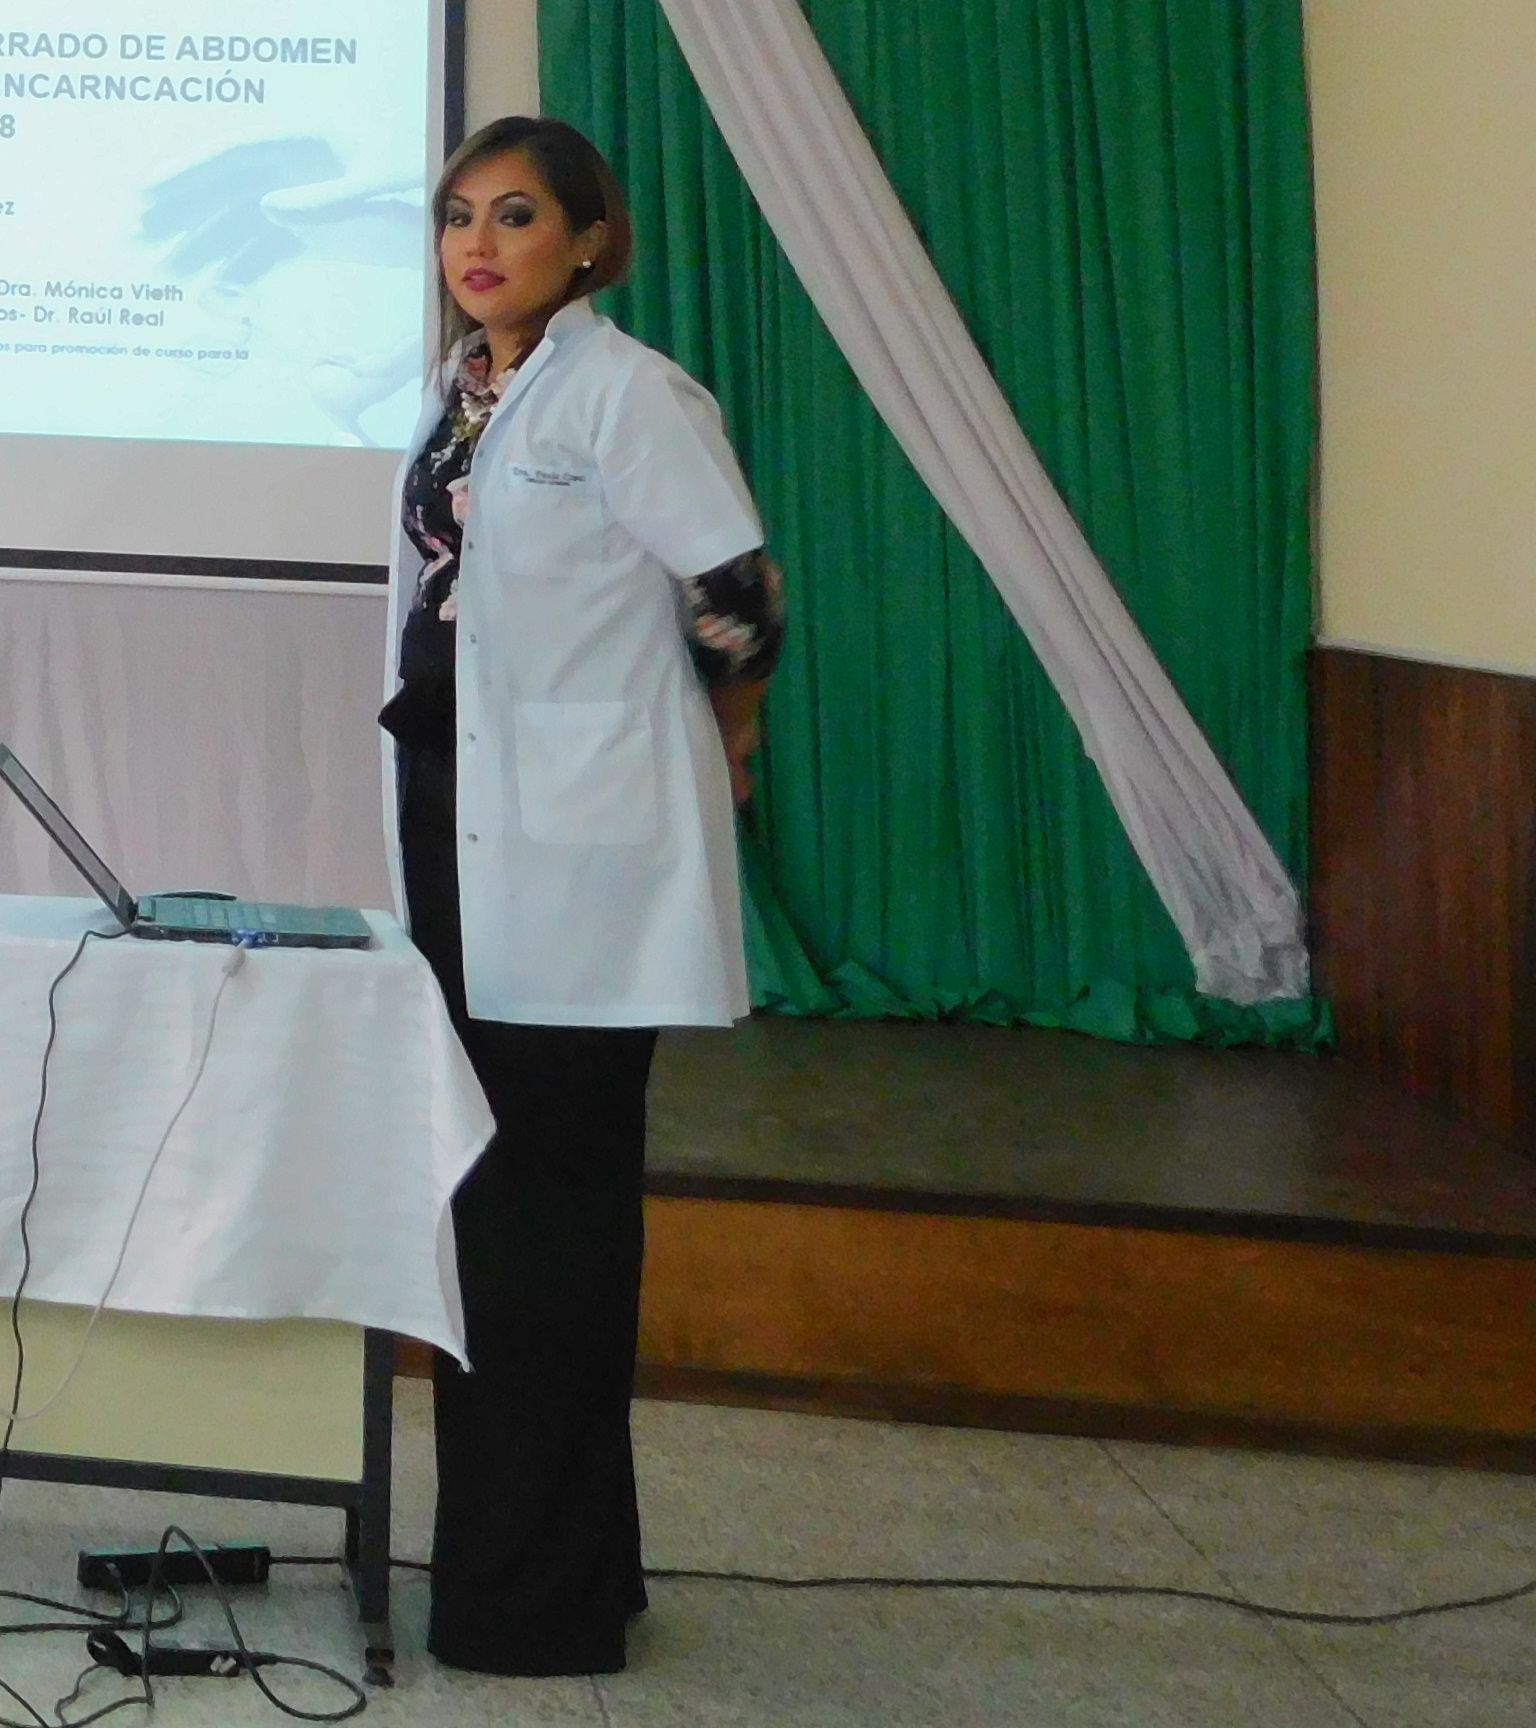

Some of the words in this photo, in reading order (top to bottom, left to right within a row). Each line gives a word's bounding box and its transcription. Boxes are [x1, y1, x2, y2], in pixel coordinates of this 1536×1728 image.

[119, 34, 166, 61] DE
[175, 35, 358, 65] ABDOMEN
[44, 280, 124, 301] Mónica
[130, 283, 184, 302] Vieth
[68, 306, 112, 326] Raúl
[119, 309, 165, 328] Real
[14, 342, 47, 354] para
[51, 342, 129, 357] promoción
[132, 345, 151, 357] de
[155, 348, 193, 359] curso
[197, 349, 231, 361] para
[235, 348, 249, 360] la
